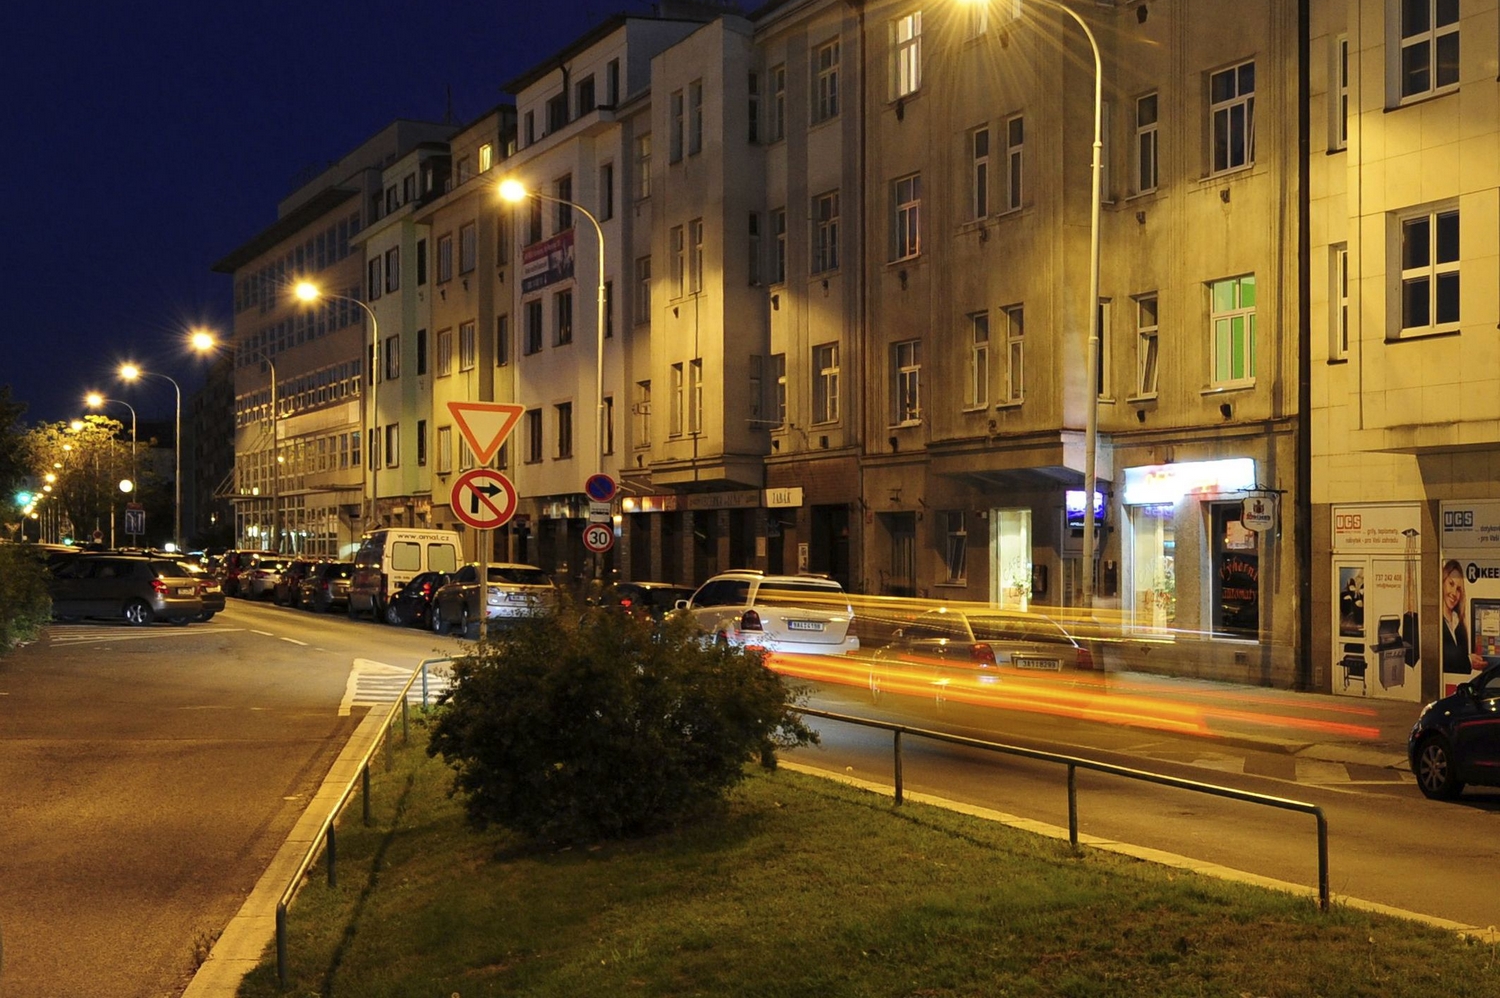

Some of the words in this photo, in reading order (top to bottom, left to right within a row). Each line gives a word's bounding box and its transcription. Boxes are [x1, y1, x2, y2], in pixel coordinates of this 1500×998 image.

[1336, 515, 1362, 530] UCS
[1444, 511, 1473, 527] UCS
[589, 531, 608, 545] 30
